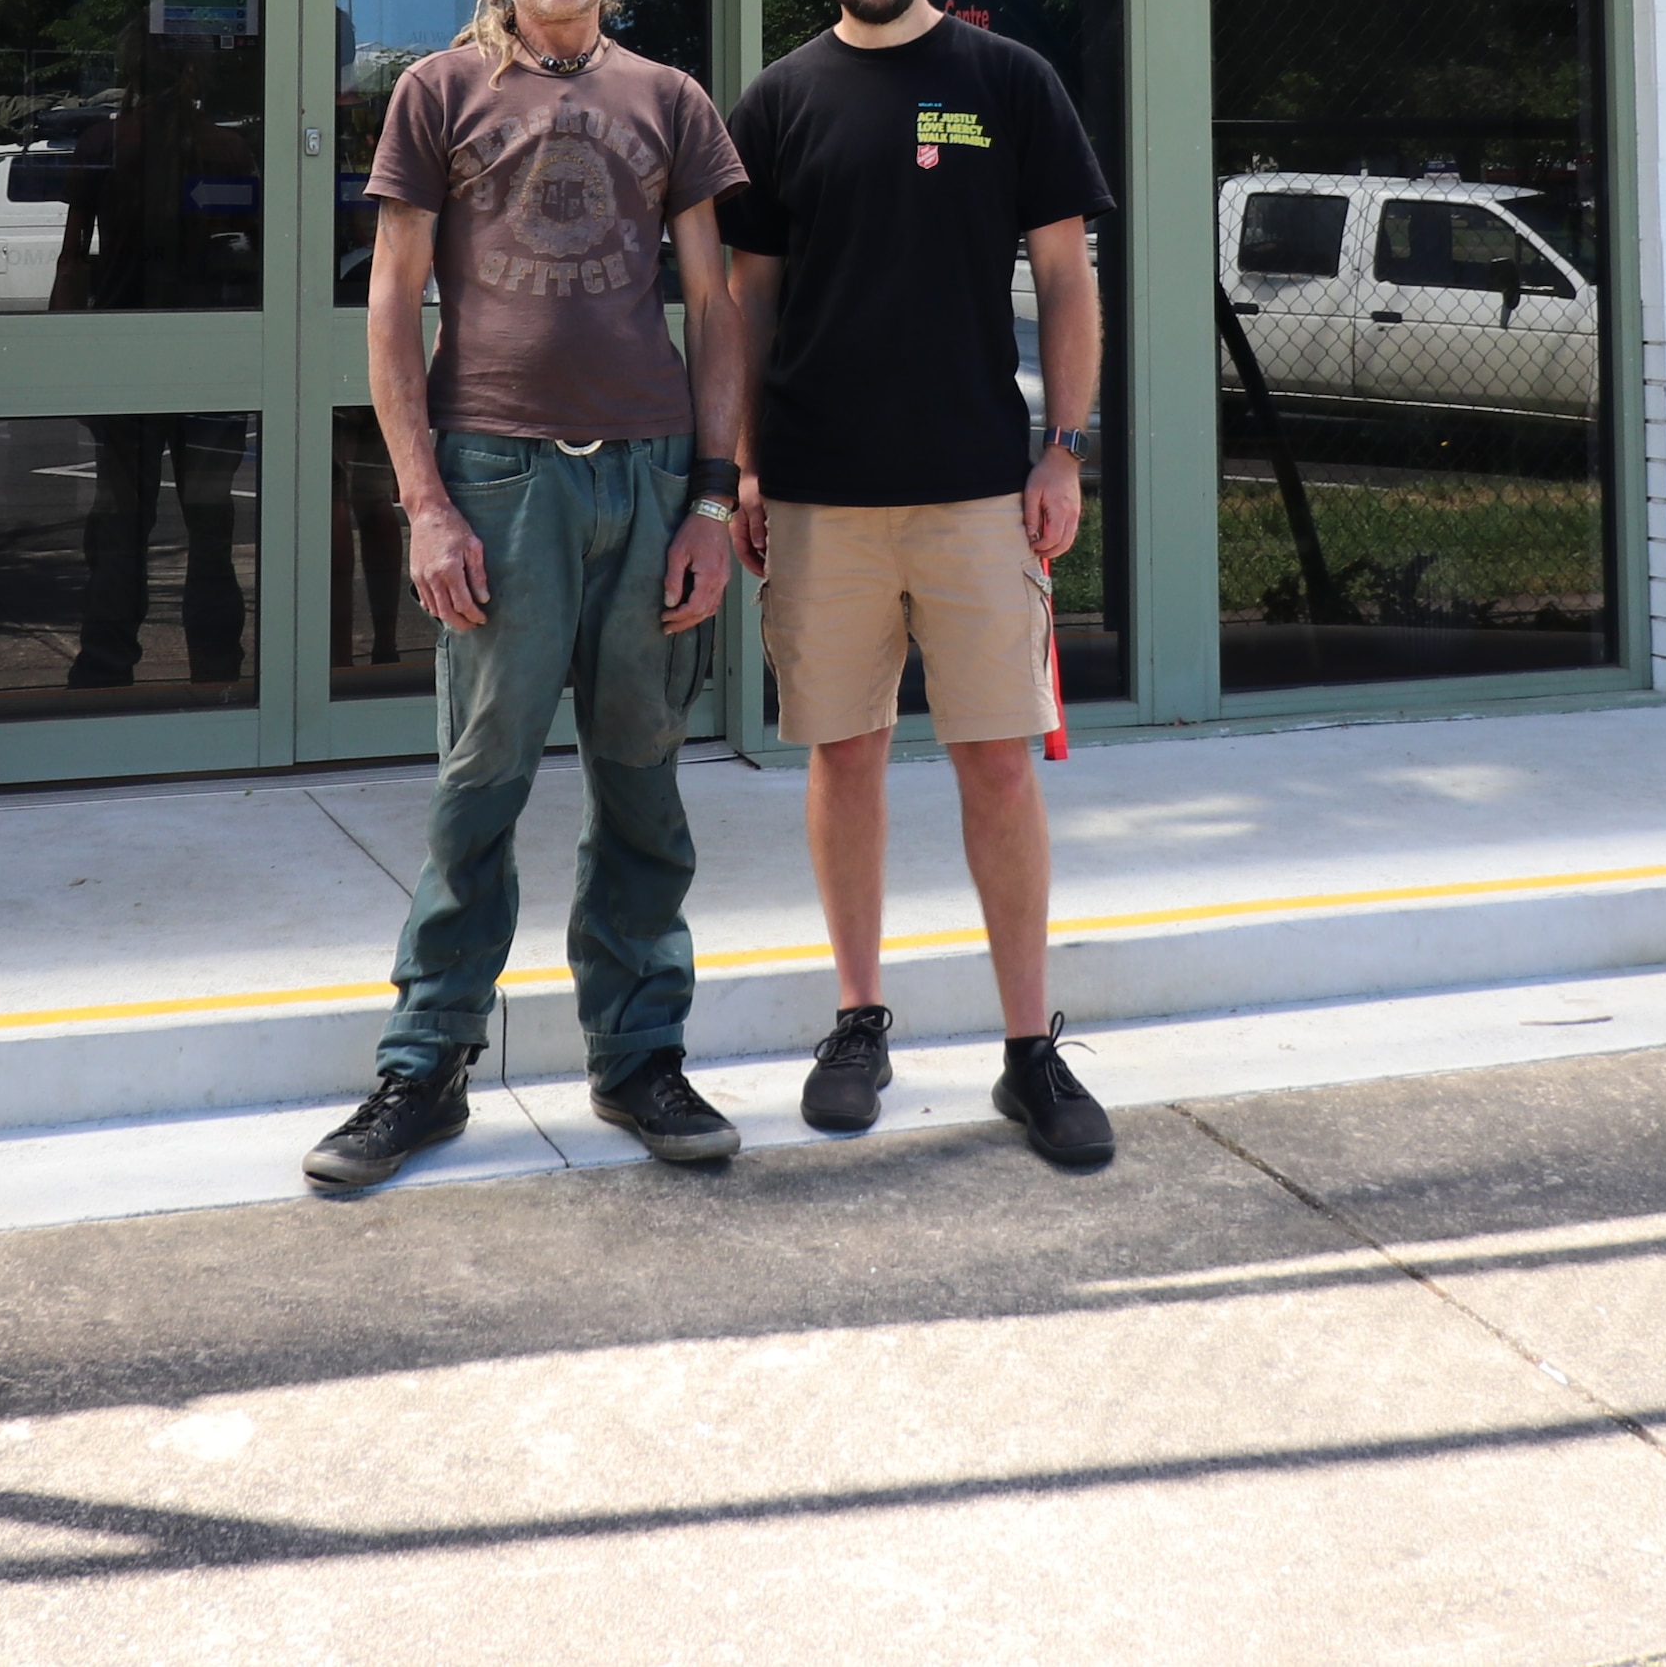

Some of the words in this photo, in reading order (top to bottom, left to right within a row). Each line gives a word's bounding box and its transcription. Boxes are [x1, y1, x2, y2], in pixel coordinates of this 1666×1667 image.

[917, 112, 940, 122] ACT
[939, 113, 978, 124] JUSTLY
[917, 122, 945, 133] LOVE
[946, 124, 983, 135] MERCY
[917, 133, 948, 143] WALK
